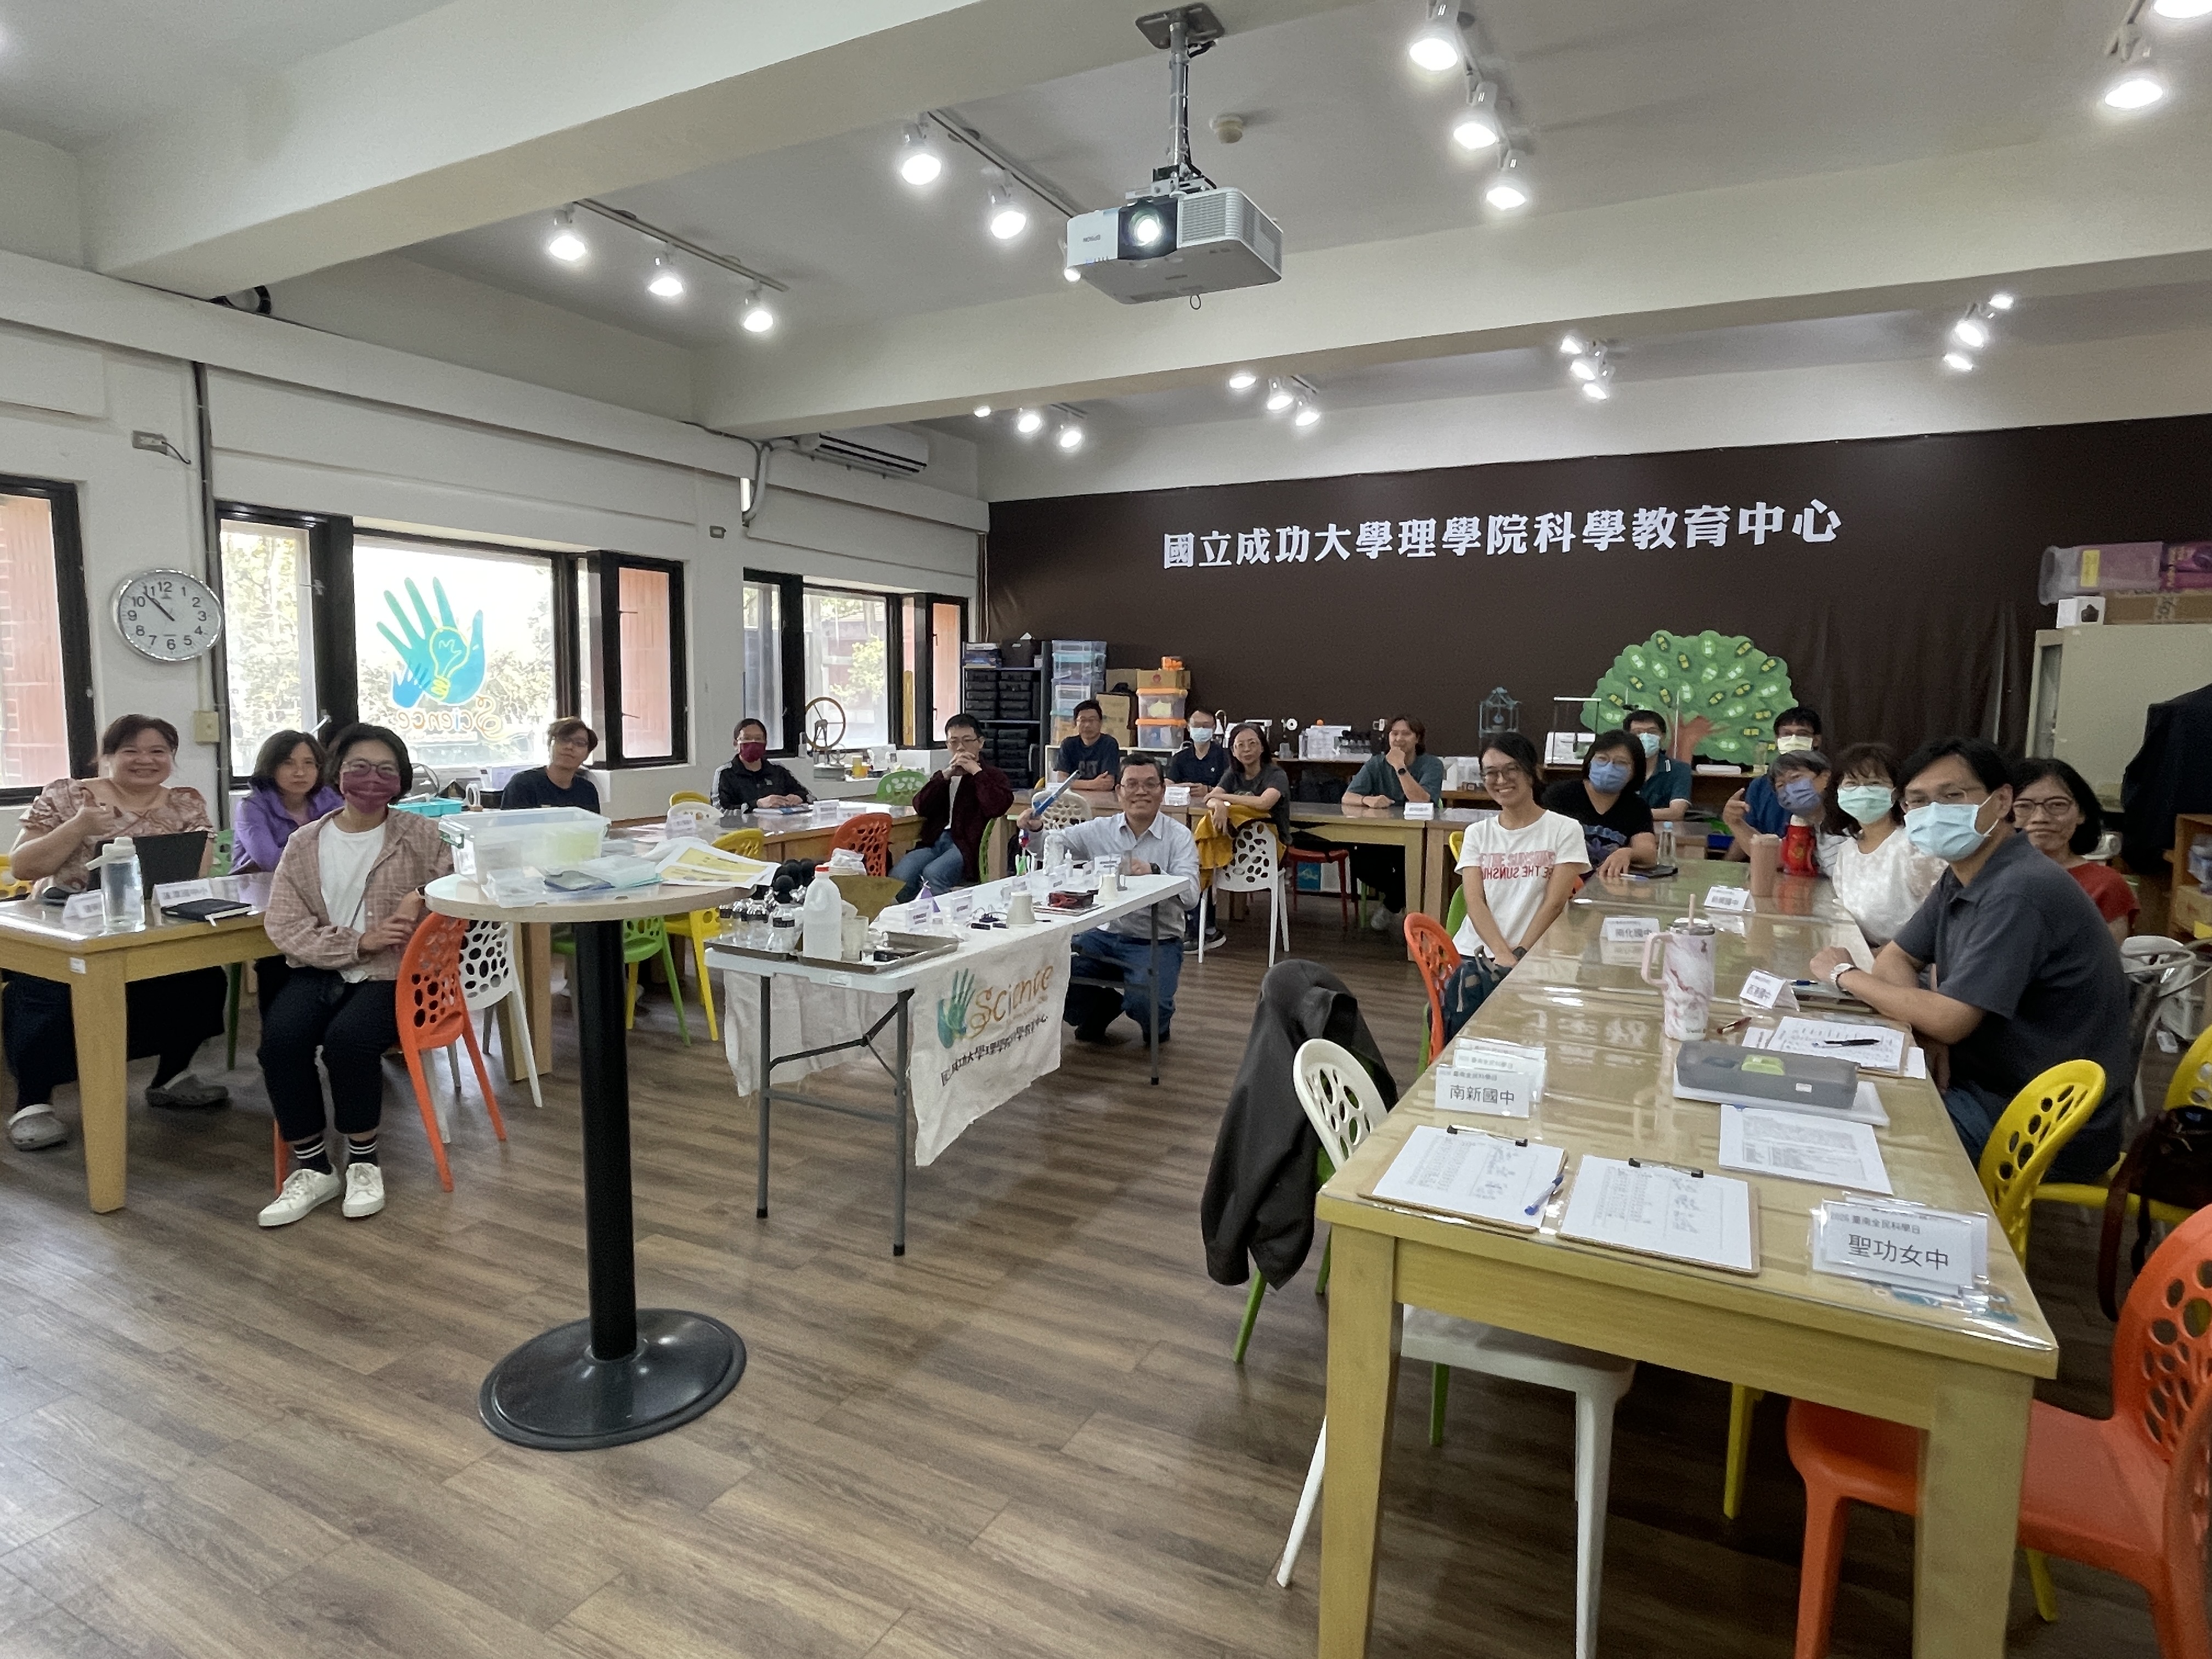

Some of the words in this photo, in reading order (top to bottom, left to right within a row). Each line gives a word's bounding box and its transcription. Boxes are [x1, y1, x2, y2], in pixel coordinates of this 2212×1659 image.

[1163, 499, 1842, 569] 國立成功大學理學院科學教育中心
[144, 586, 155, 596] 11
[158, 582, 172, 592] 12
[182, 586, 187, 596] 1
[132, 596, 146, 607] 10
[192, 597, 201, 607] 2
[127, 610, 137, 621] 9
[198, 611, 207, 622] 3
[136, 625, 145, 636] 8
[194, 625, 203, 635] 4
[149, 635, 157, 645] 7
[167, 639, 176, 650] 6
[184, 635, 192, 646] 5
[1450, 1084, 1514, 1105] 南新國中
[1848, 1234, 1948, 1270] 聖功女中
